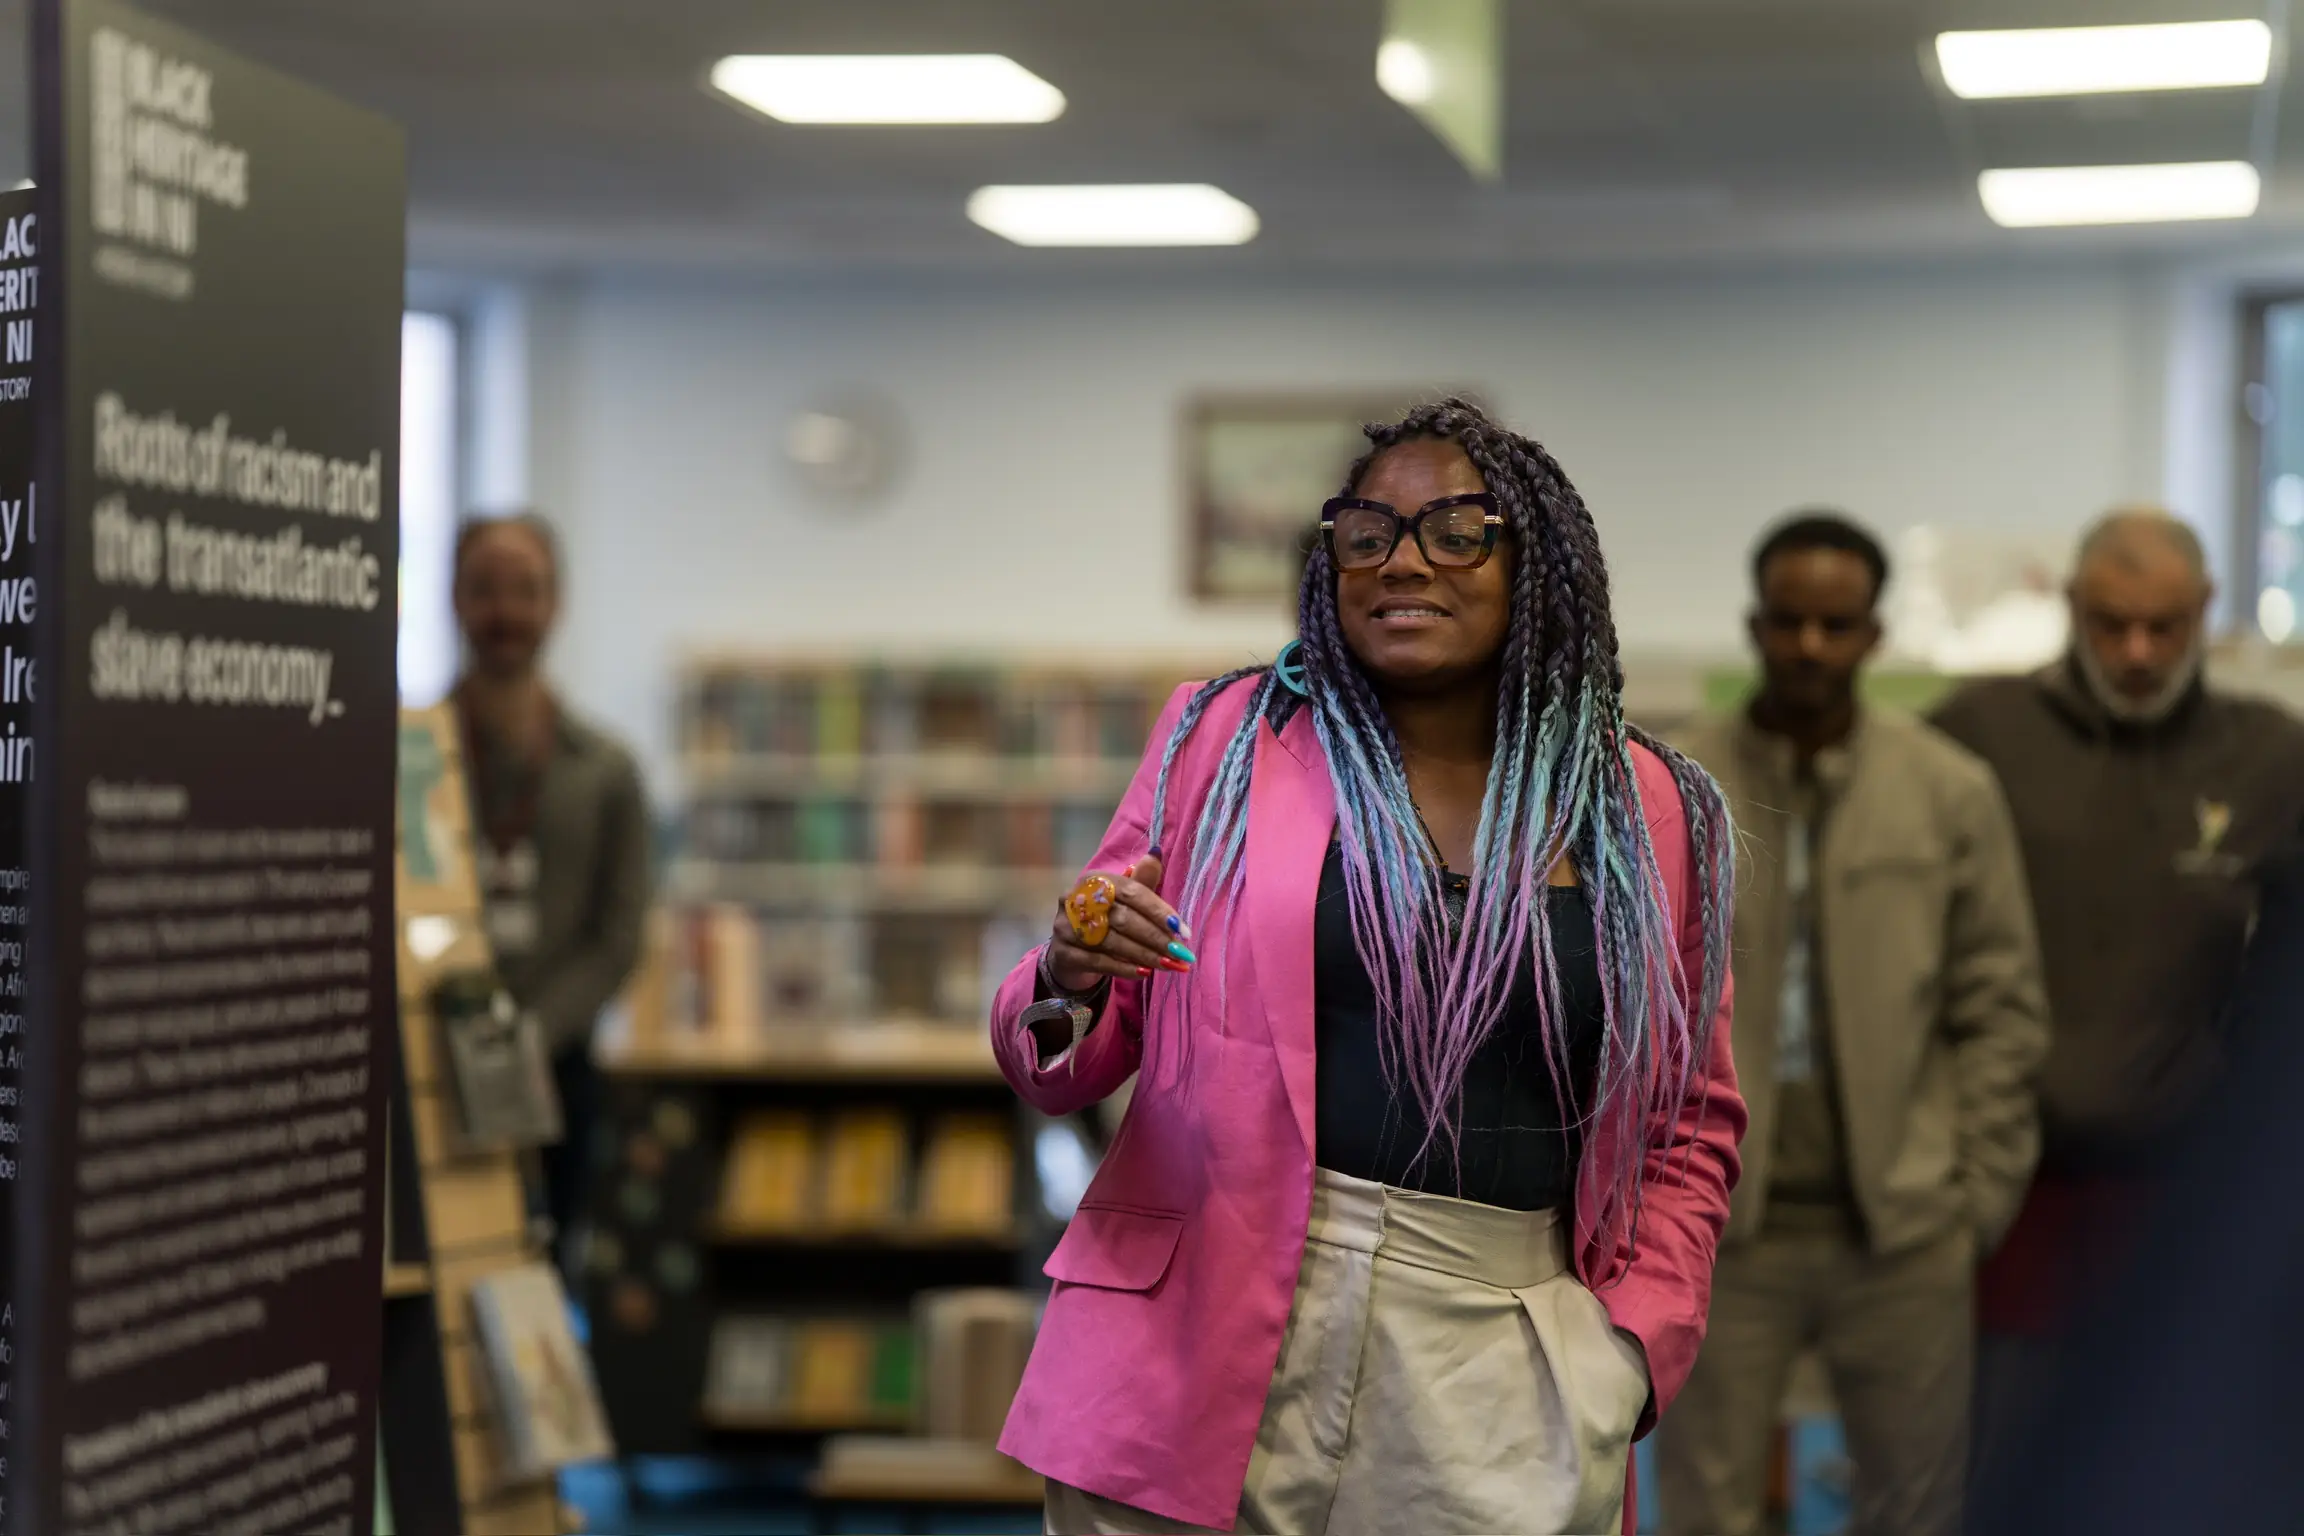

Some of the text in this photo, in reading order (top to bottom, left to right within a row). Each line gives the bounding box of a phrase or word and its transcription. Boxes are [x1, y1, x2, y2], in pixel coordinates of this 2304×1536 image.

[0, 212, 36, 261] AC
[7, 319, 33, 363] NI
[96, 393, 380, 521] Roots of racism and
[95, 495, 379, 610] the transatlantic
[92, 608, 344, 725] slave economy.
